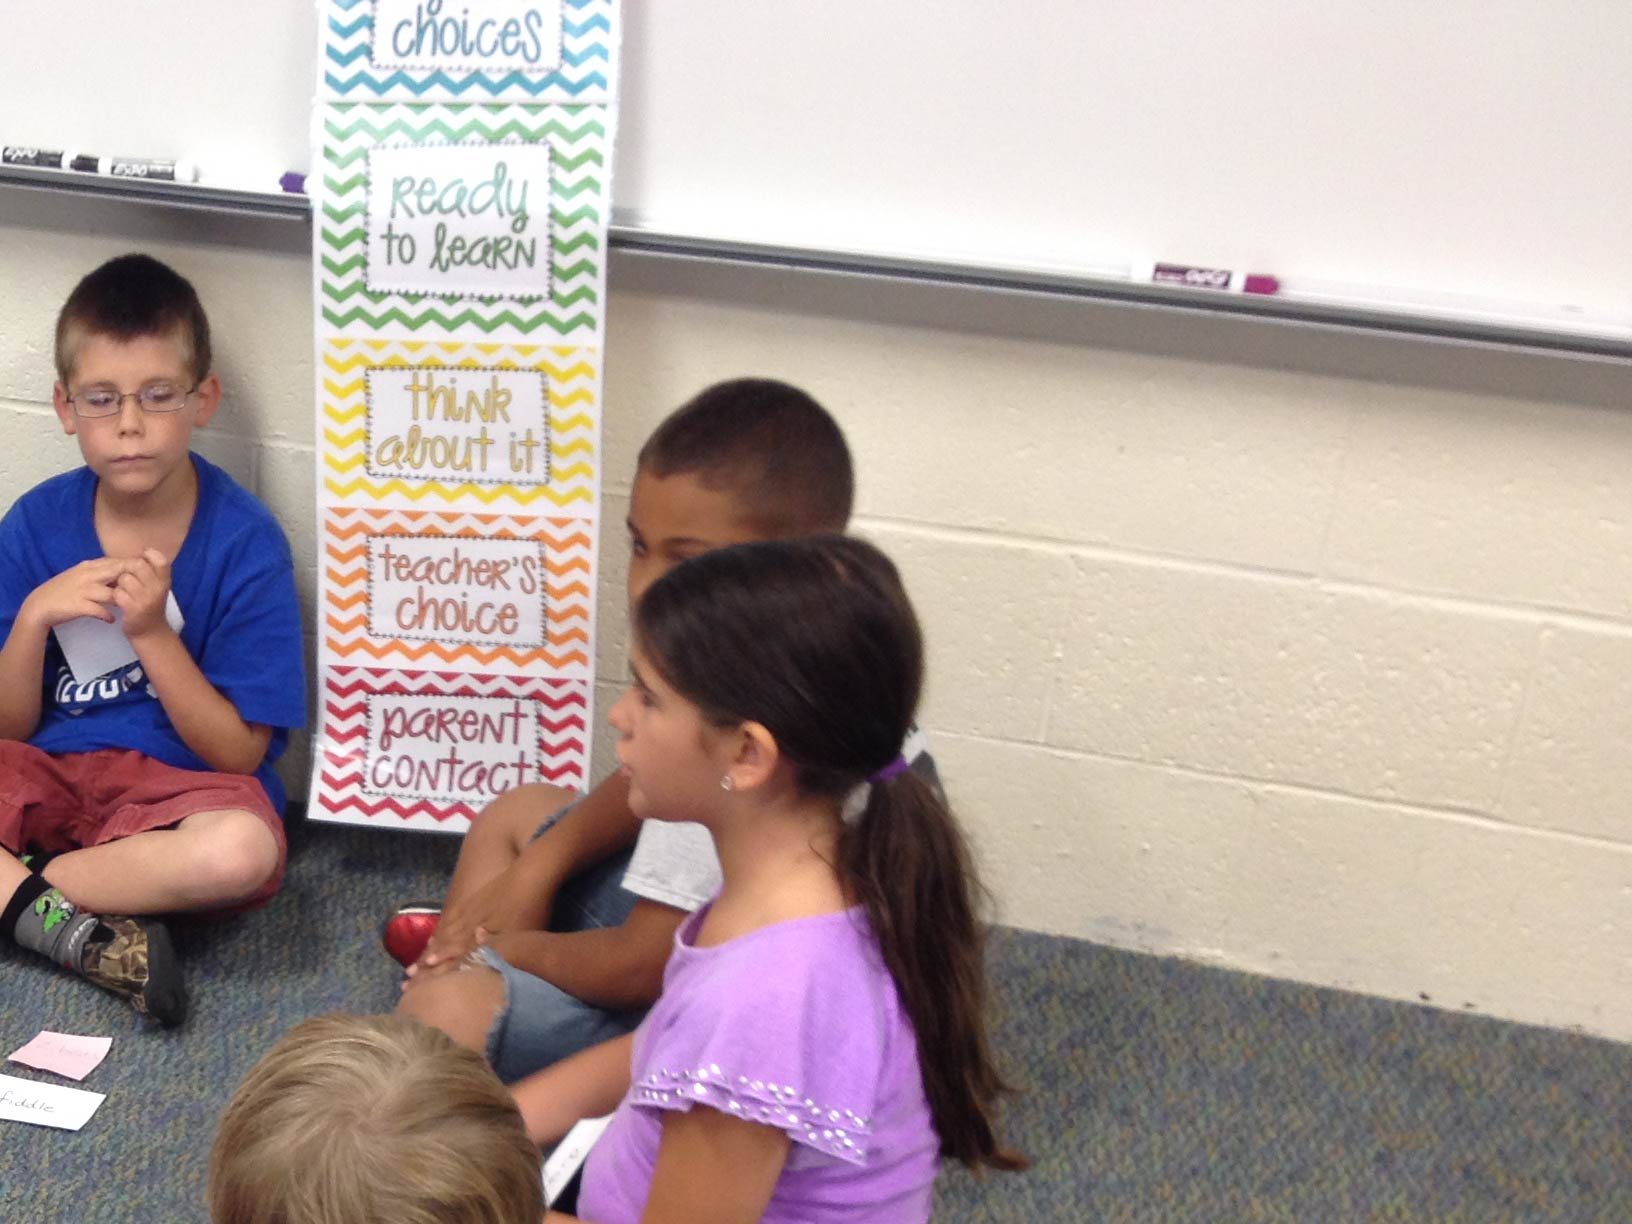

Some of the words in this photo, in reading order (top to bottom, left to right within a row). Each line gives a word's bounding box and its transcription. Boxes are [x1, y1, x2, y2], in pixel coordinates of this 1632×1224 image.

[392, 4, 543, 64] choices
[380, 224, 416, 265] to
[375, 425, 495, 471] about
[509, 432, 540, 473] it
[396, 587, 519, 634] choice
